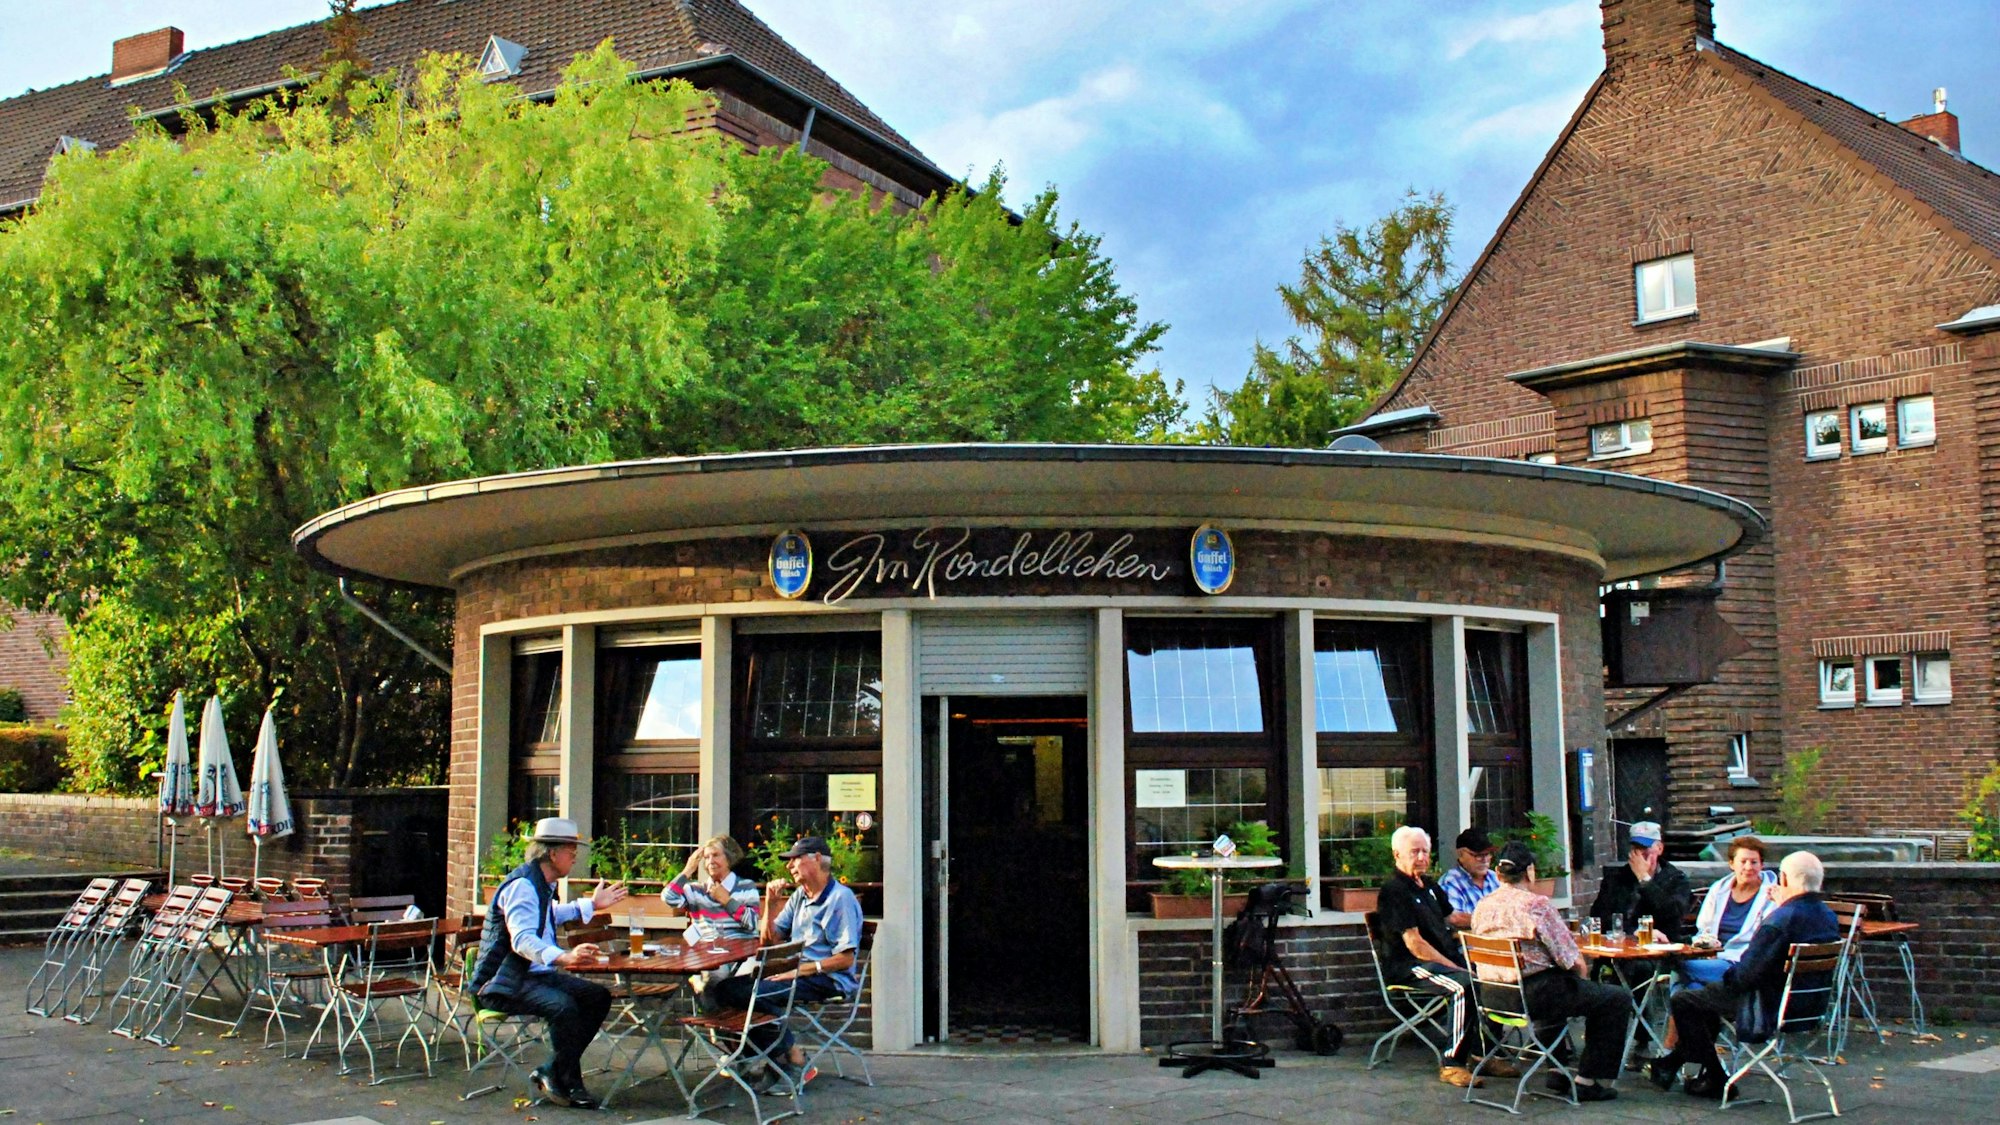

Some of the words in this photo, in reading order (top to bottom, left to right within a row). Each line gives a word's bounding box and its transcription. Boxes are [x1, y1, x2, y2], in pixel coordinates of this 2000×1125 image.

[776, 556, 805, 569] Gaffel
[1197, 551, 1227, 564] Gaffel
[823, 533, 908, 604] Im
[913, 526, 1170, 600] Rondellchen
